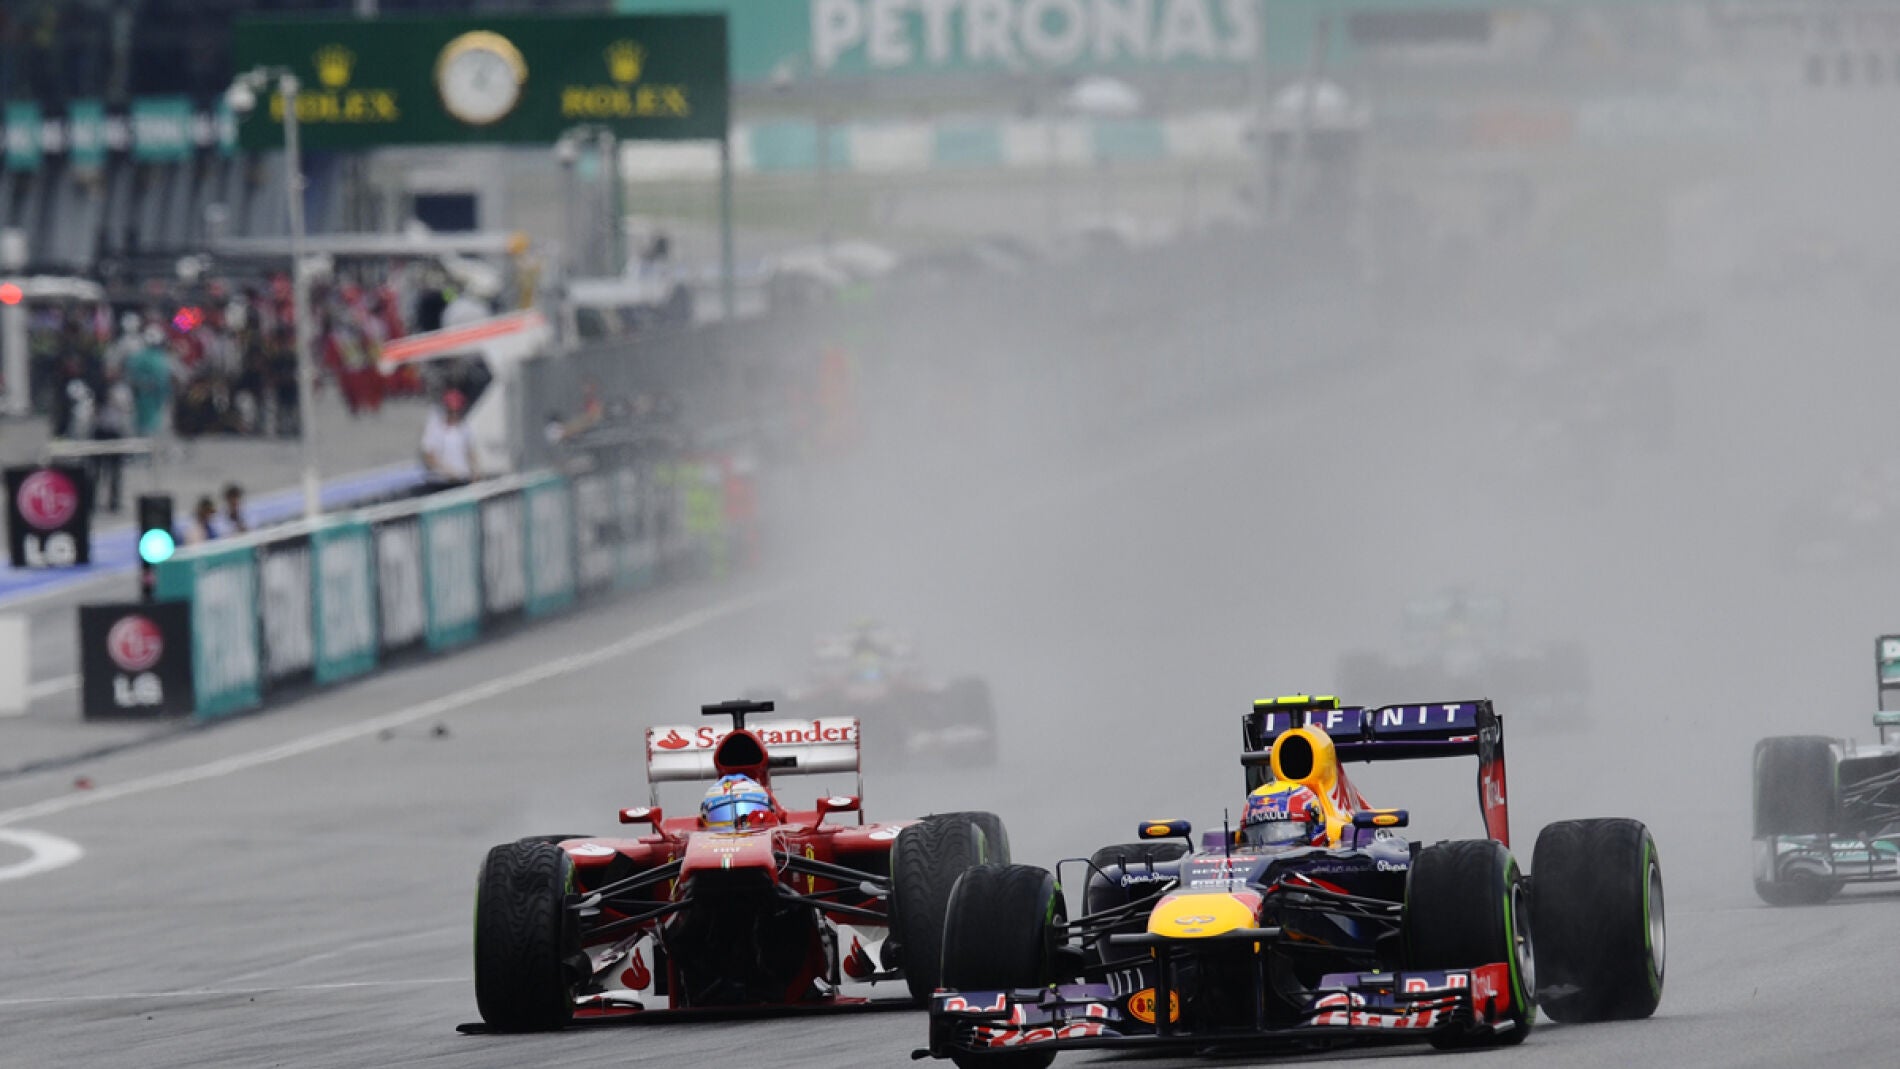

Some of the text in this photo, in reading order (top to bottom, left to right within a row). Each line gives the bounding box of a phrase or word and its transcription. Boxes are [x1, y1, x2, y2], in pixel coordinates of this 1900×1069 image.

[810, 0, 1257, 68] PETRONAS
[561, 85, 690, 117] ROLEX
[24, 531, 77, 567] LG
[113, 671, 163, 707] LG
[695, 720, 852, 749] Stander
